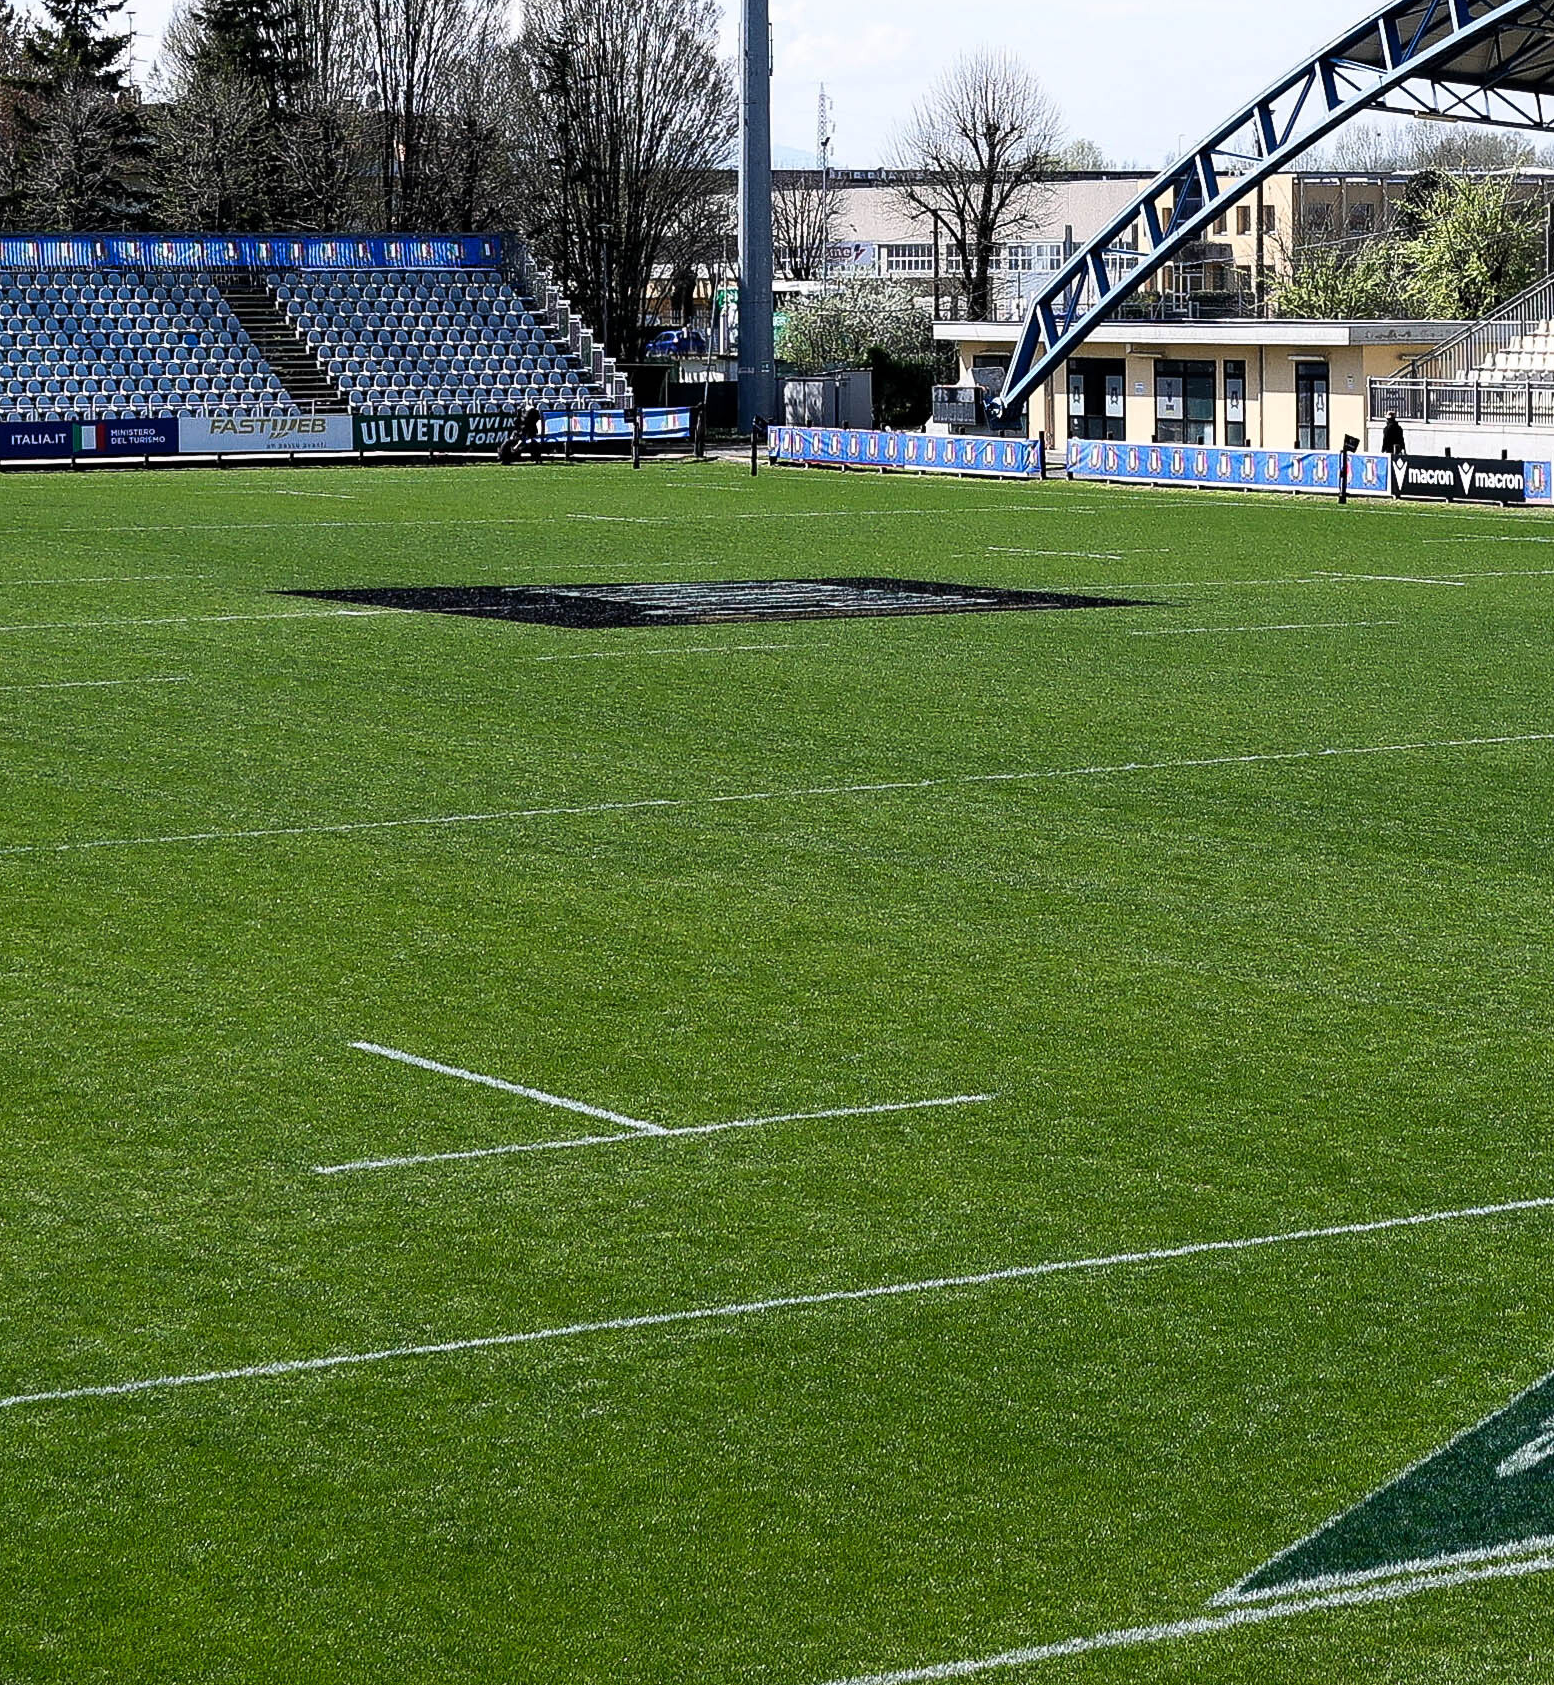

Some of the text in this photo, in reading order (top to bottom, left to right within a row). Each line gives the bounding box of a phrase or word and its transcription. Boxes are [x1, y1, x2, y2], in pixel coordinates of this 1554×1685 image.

[209, 418, 326, 438] FASTWEB
[360, 419, 459, 444] ULIVETO
[468, 417, 500, 430] VIVI
[11, 433, 67, 446] ITALIA.IT
[110, 428, 156, 437] MINISTERO
[110, 435, 166, 445] DEL TURISMO
[1408, 466, 1454, 486] macron
[1475, 470, 1524, 490] macron
